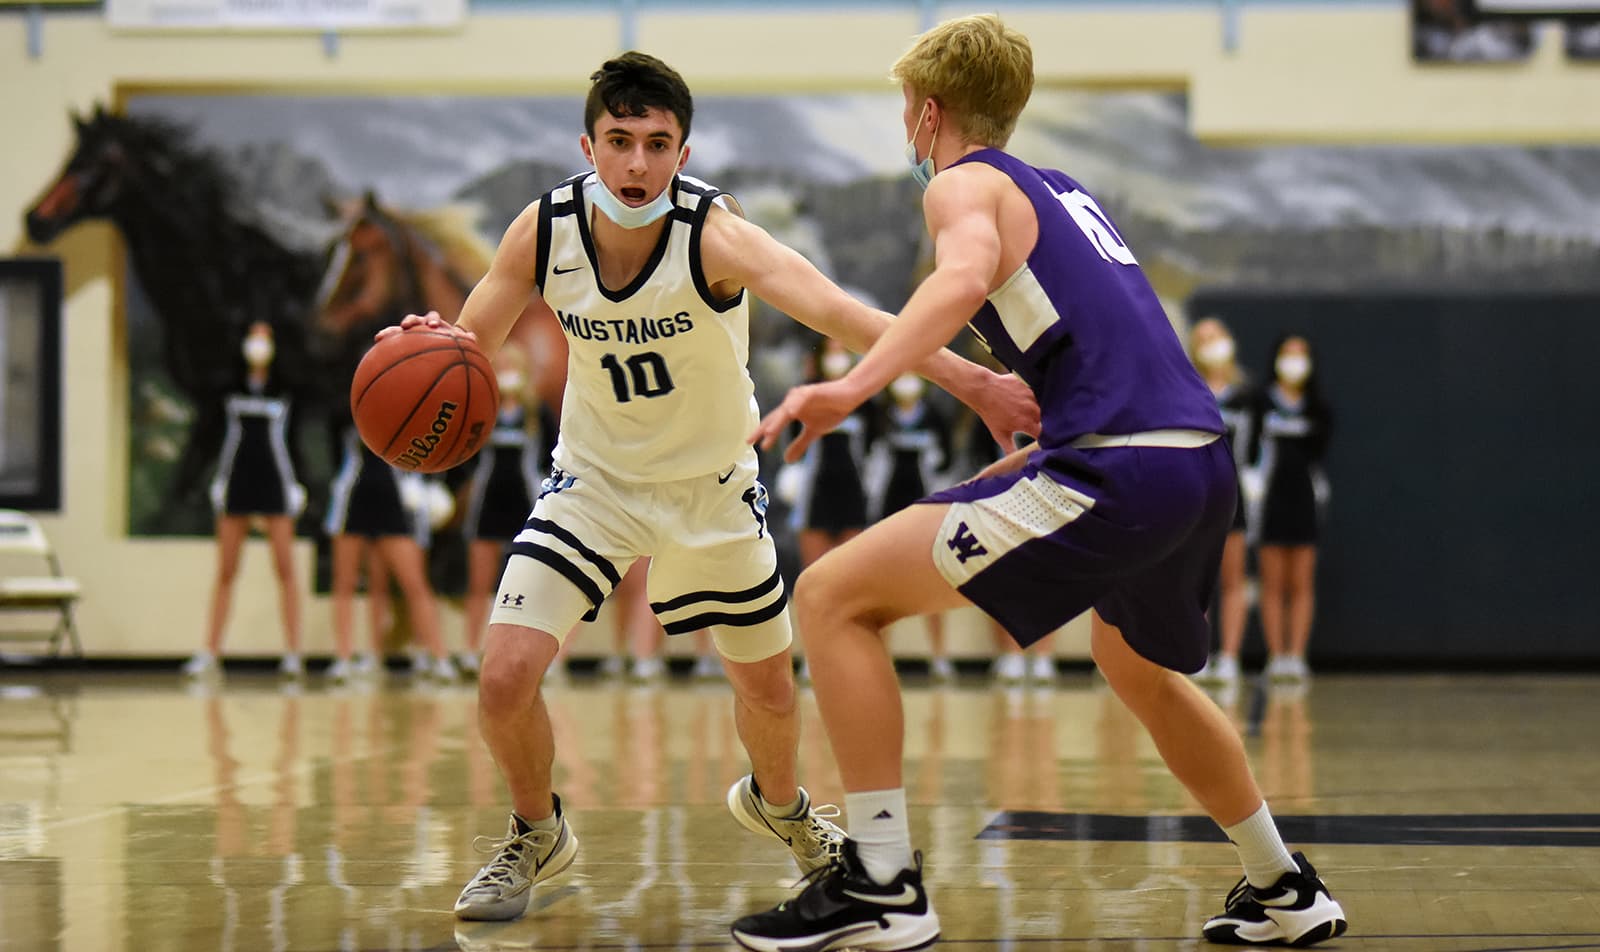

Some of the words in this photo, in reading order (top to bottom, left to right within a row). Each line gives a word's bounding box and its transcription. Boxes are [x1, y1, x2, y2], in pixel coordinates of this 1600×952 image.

[557, 310, 693, 344] MUSTANGS
[600, 351, 675, 403] 10
[947, 521, 988, 564] W
